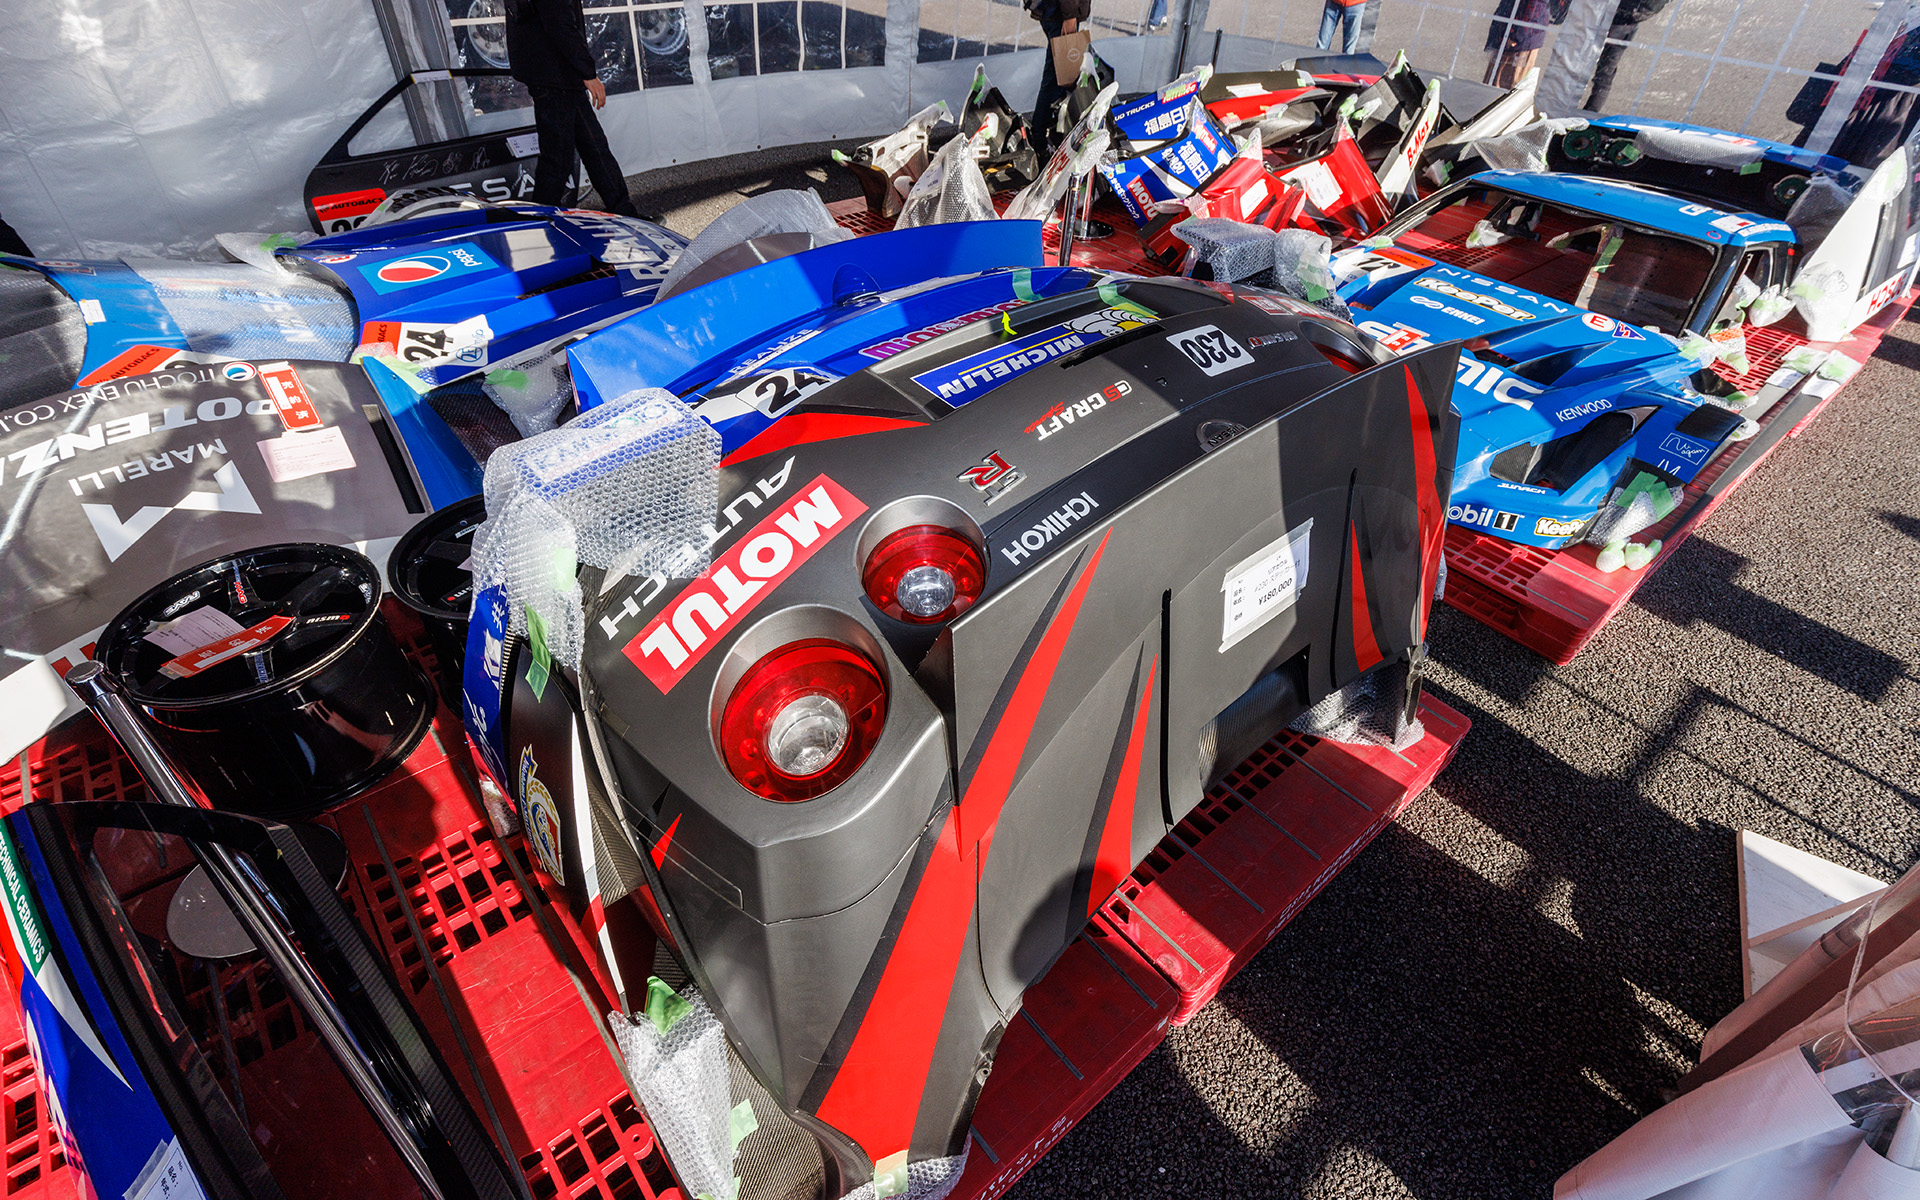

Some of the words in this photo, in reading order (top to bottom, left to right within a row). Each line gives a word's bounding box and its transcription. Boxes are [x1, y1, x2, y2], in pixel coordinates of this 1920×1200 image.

[1126, 101, 1155, 117] TRUCKS
[331, 197, 384, 210] AUTOBACS
[1130, 181, 1158, 218] MOTU
[450, 248, 483, 267] pepsi
[1418, 278, 1536, 320] KeePer
[1437, 268, 1568, 313] NISSAN
[728, 328, 813, 374] REALIZE
[936, 335, 1085, 399] MICHELIN
[1180, 330, 1242, 368] 230
[58, 385, 121, 413] ENEX
[124, 368, 215, 397] ITOCHU
[1024, 402, 1064, 434] Sports
[1038, 392, 1107, 441] CRAFT
[1556, 398, 1612, 422] KENWOOD
[0, 397, 281, 487] POTENZ
[68, 438, 228, 496] MARELLI
[1001, 491, 1099, 566] ICHIKOH
[1448, 504, 1493, 526] obil
[640, 485, 843, 671] MOTUL
[306, 614, 351, 625] nismo
[16, 894, 45, 964] CERAMICS
